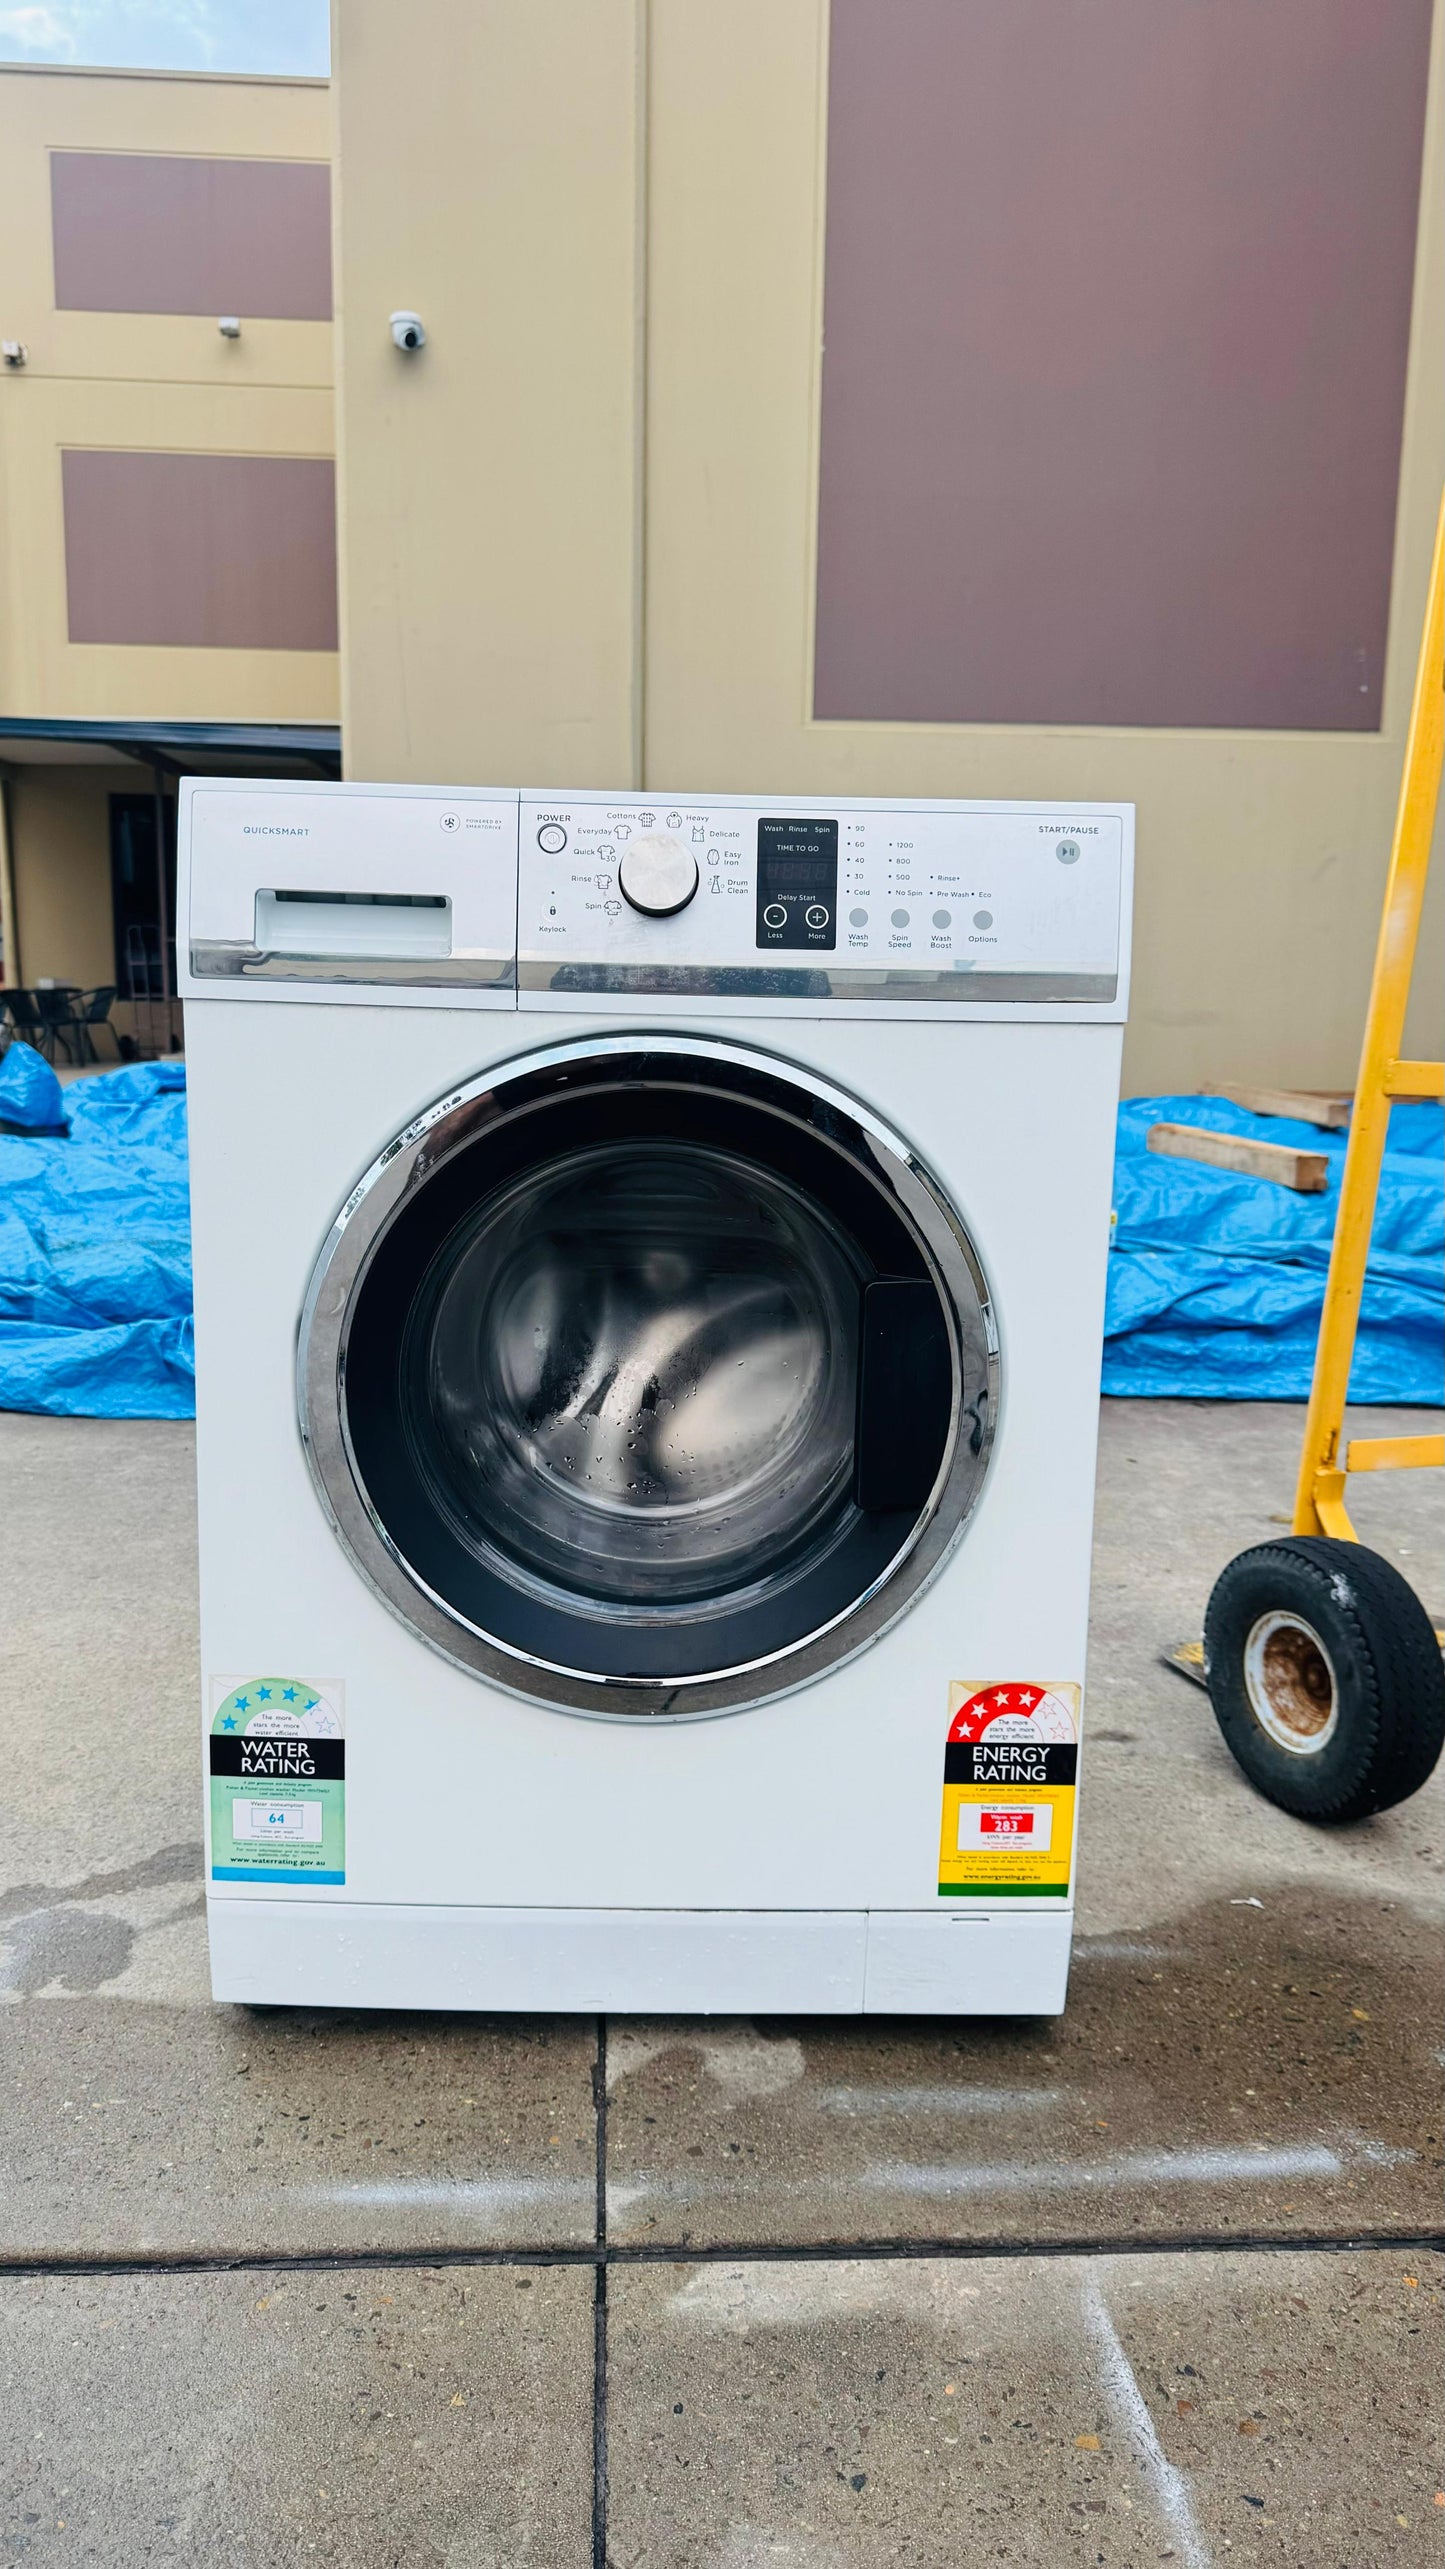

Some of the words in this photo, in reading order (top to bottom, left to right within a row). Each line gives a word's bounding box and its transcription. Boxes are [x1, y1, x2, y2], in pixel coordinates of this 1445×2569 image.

[537, 814, 571, 822] POWER
[606, 812, 636, 820] Cottons
[686, 815, 709, 823] Heavy
[243, 826, 310, 836] QUICKSMART
[577, 828, 612, 836] Everyday
[1038, 826, 1099, 835] START/PAUSE
[573, 848, 595, 856] Quick
[724, 851, 742, 860] Easy
[571, 875, 592, 883] Rinse
[778, 894, 797, 902] Delay
[585, 903, 602, 911] Spin
[888, 941, 911, 949] Speed
[241, 1740, 310, 1758] WATER
[973, 1746, 1050, 1762] ENERGY
[241, 1757, 315, 1775] RATING
[974, 1765, 1047, 1781] RATING
[269, 1813, 284, 1824] 64
[994, 1821, 1018, 1831] 283
